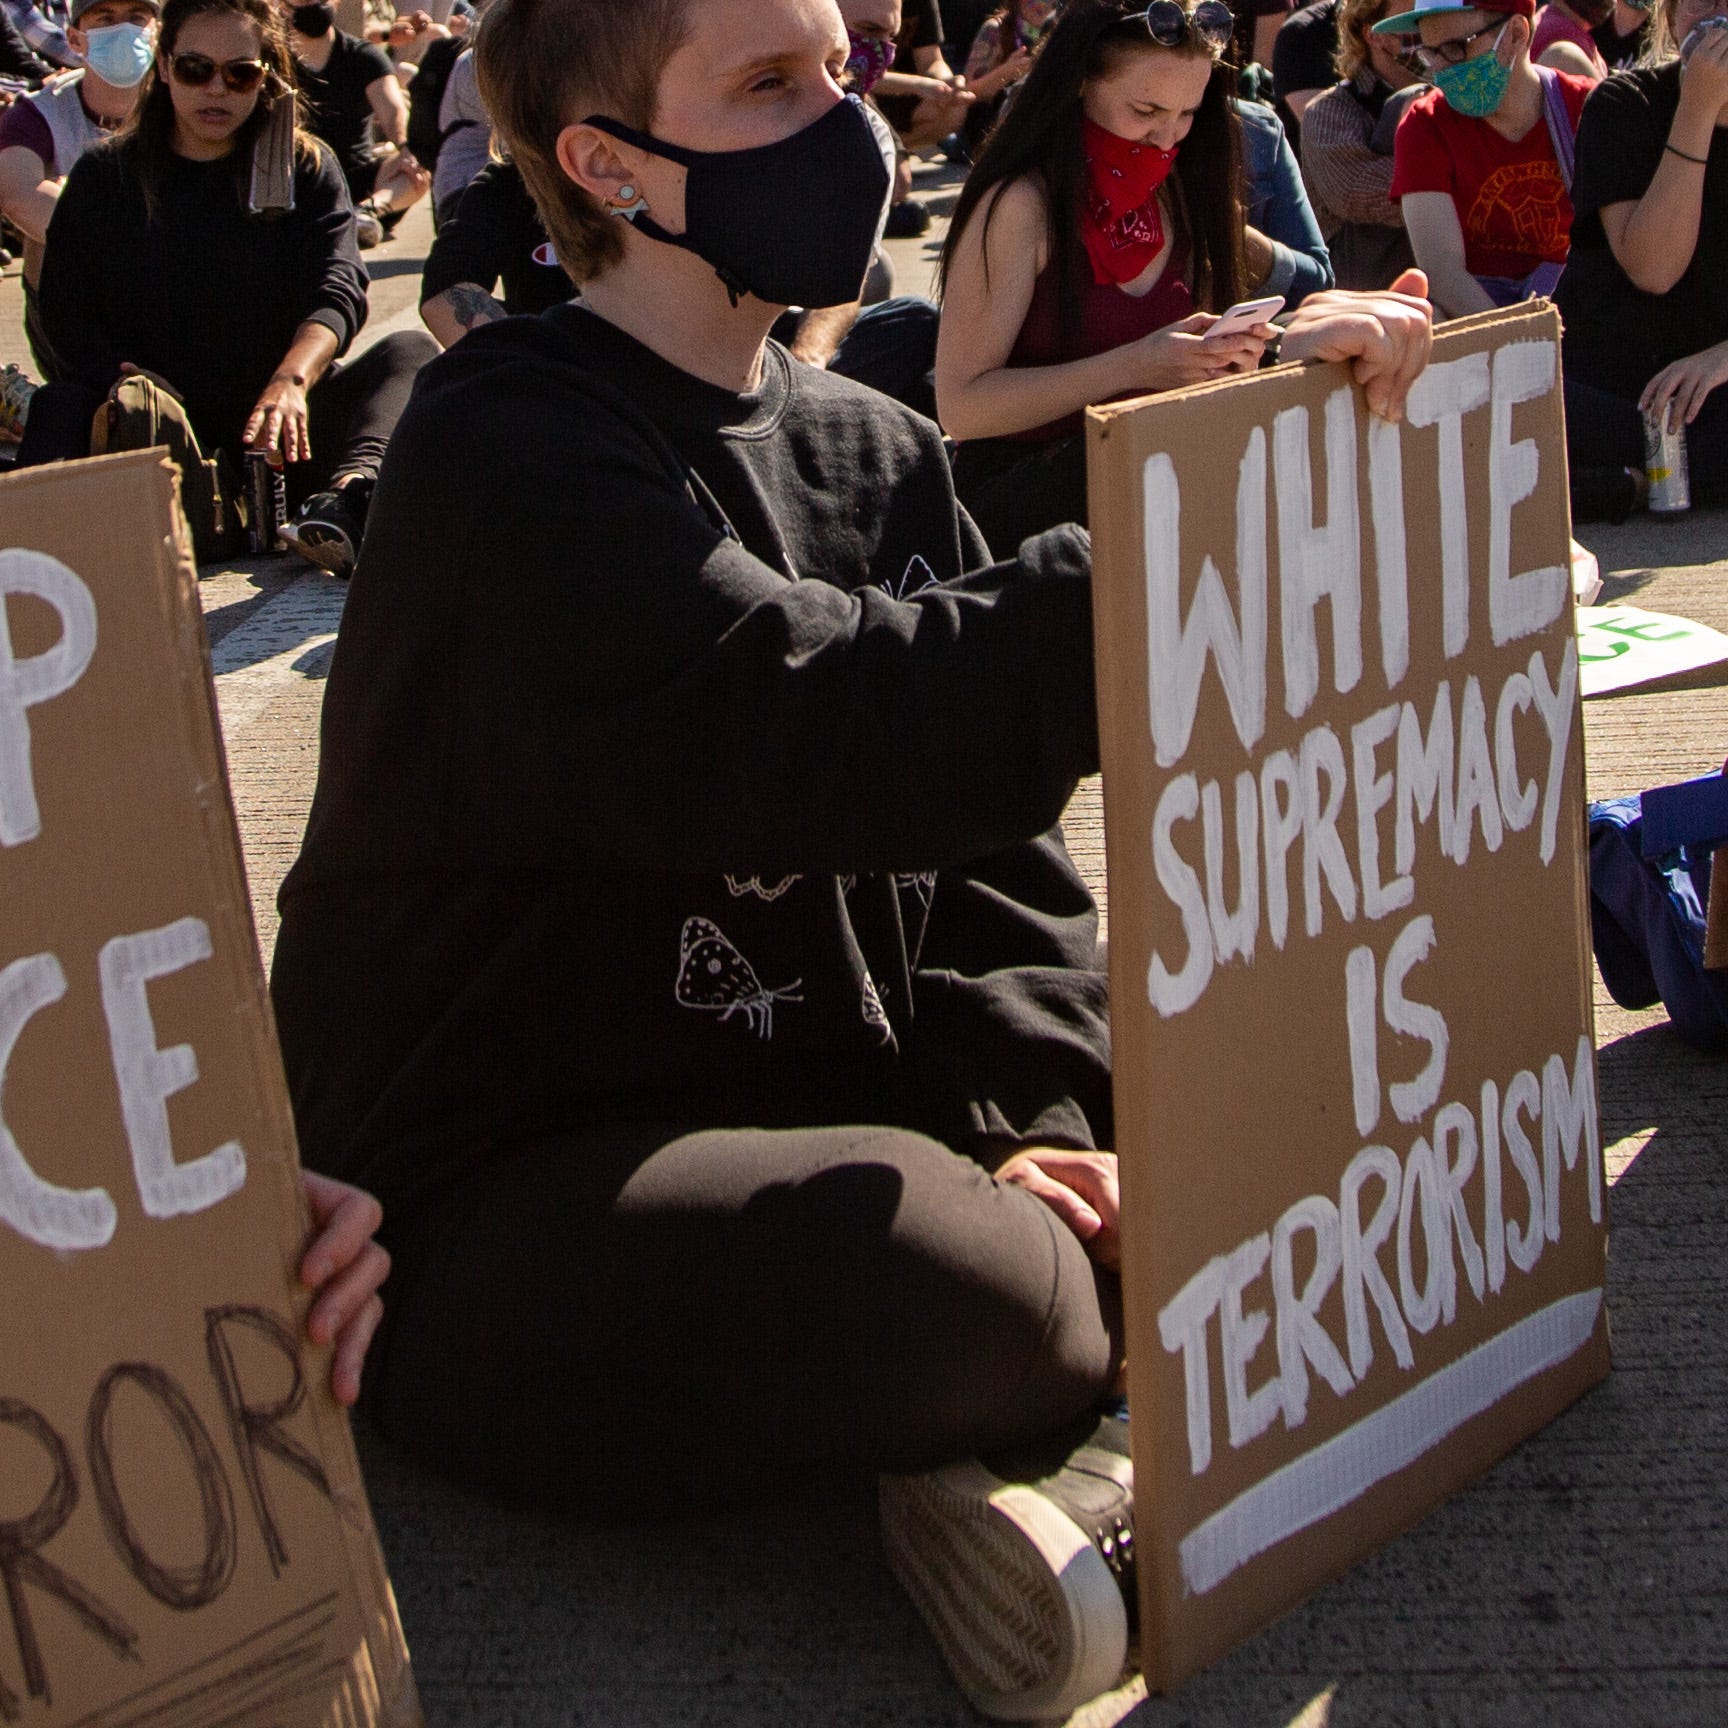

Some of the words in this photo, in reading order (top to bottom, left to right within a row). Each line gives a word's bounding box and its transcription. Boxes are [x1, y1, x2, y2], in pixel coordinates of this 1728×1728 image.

[1142, 339, 1568, 767] WHITE
[1146, 634, 1579, 1018] SUPREMACY
[1345, 915, 1449, 1137] IS
[1157, 1034, 1602, 1475] TERRORISM
